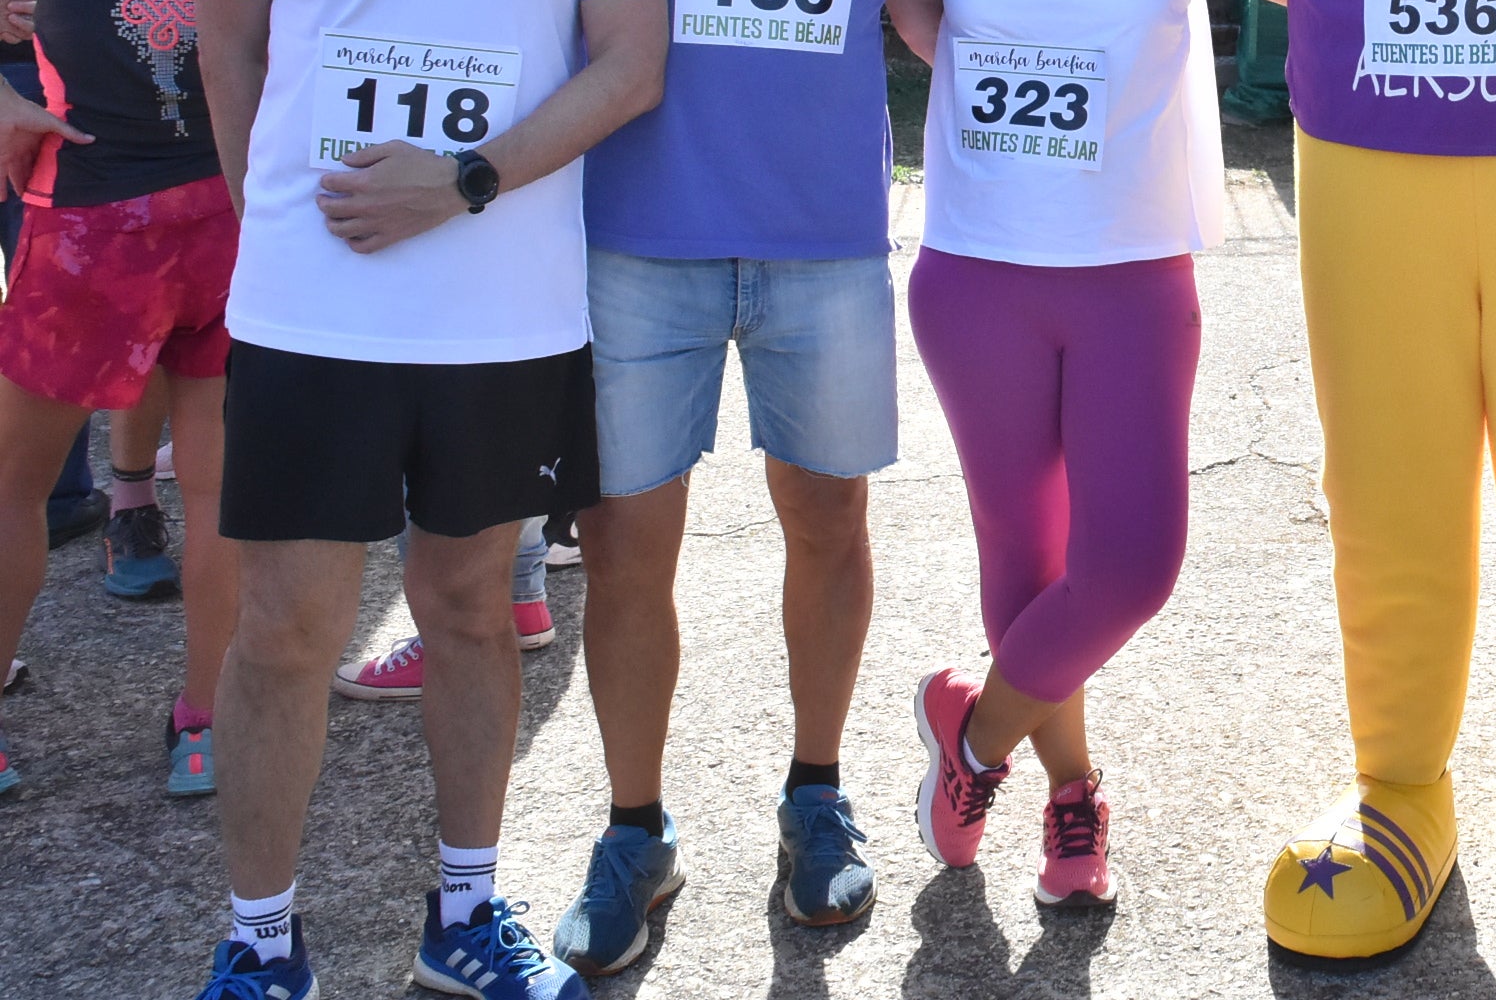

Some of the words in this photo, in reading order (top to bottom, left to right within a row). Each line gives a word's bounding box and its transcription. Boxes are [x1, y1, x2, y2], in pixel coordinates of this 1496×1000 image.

[681, 13, 763, 39] FUENTES
[767, 18, 791, 41] DE
[794, 18, 843, 46] BÉJAR
[336, 45, 415, 70] marcha
[420, 49, 503, 78] benéfica
[969, 48, 1031, 70] marcha
[1034, 50, 1099, 75] benéfica
[1371, 42, 1440, 65] FUENTES
[1442, 43, 1465, 65] DE
[346, 77, 490, 143] 118
[971, 76, 1090, 131] 323
[961, 128, 1019, 153] FUENTES
[1022, 134, 1044, 156] DE
[1046, 134, 1099, 162] BÉJAR
